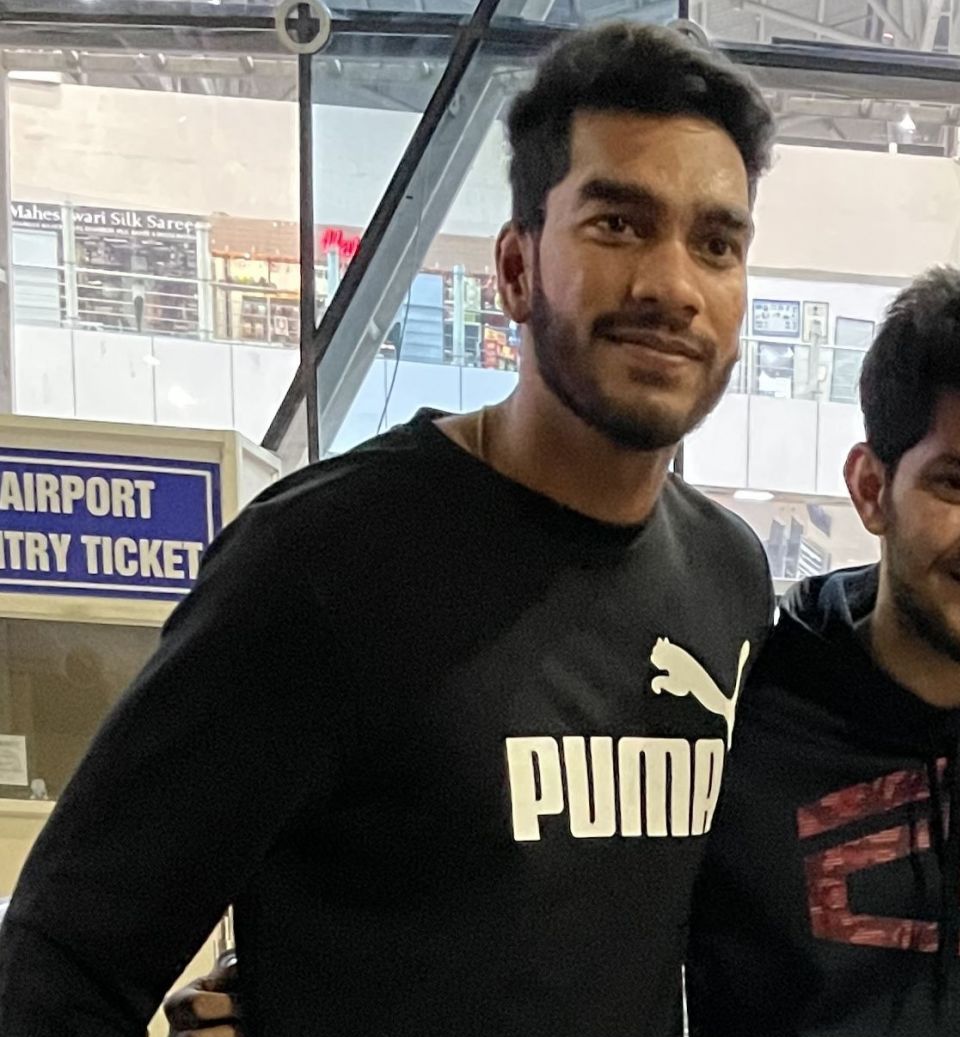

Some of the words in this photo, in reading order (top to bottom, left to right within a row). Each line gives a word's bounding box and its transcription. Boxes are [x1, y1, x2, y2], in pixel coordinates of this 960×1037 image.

[11, 204, 105, 226] Maheswari
[110, 212, 143, 228] Silk
[147, 215, 201, 234] Saree
[0, 471, 155, 519] AIRPORT
[0, 530, 71, 572] TRY
[80, 535, 204, 580] TICKET
[505, 735, 725, 841] PUMA
